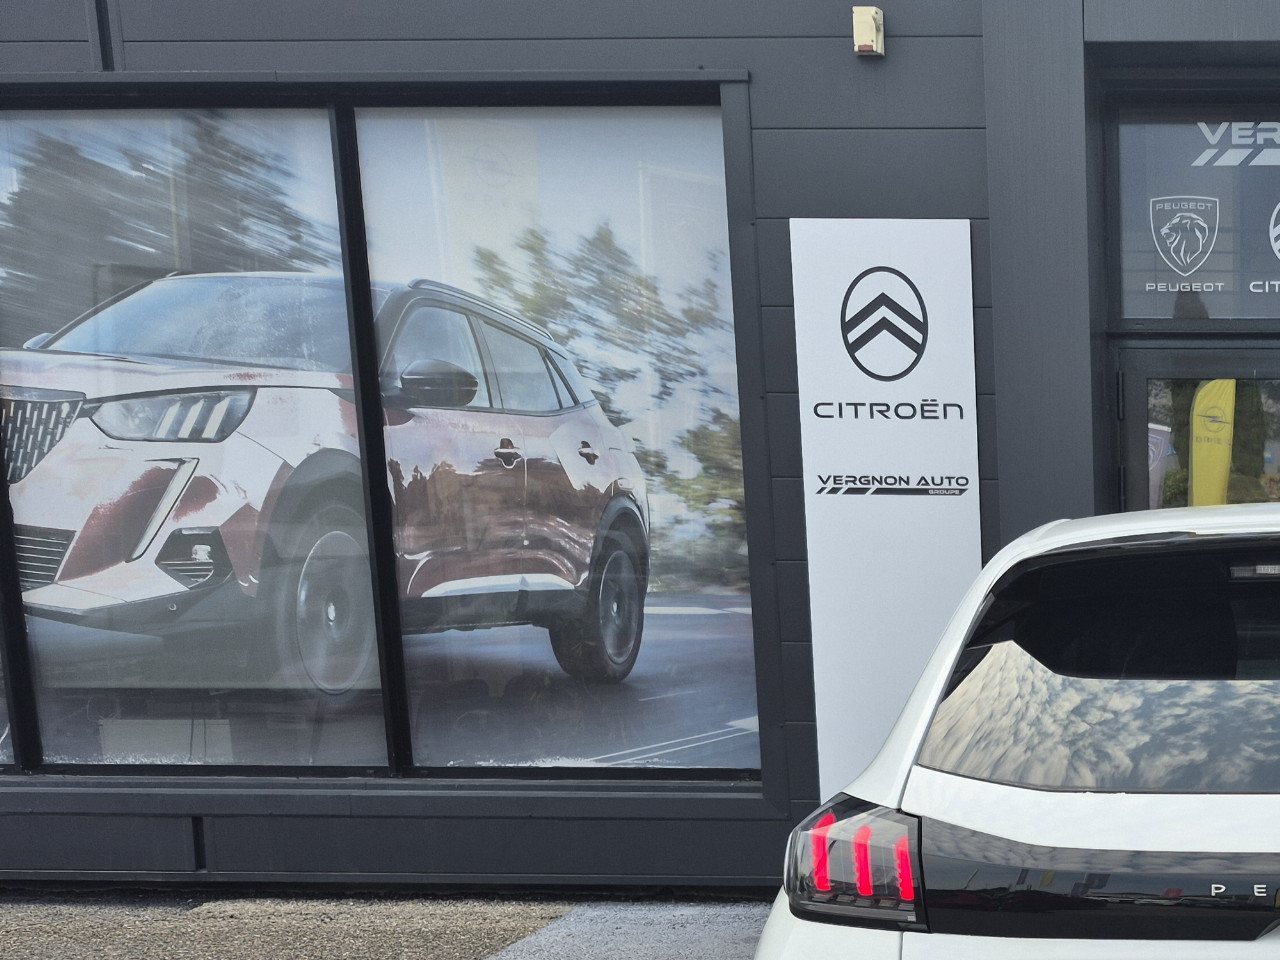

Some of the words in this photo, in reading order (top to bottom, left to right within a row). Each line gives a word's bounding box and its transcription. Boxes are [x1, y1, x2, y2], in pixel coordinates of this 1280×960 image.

[1155, 202, 1213, 211] PEUGEOT
[1145, 282, 1224, 292] PEUGEOT
[813, 399, 964, 420] CITROËN
[816, 475, 910, 487] VERGNON
[916, 475, 970, 487] AUTO
